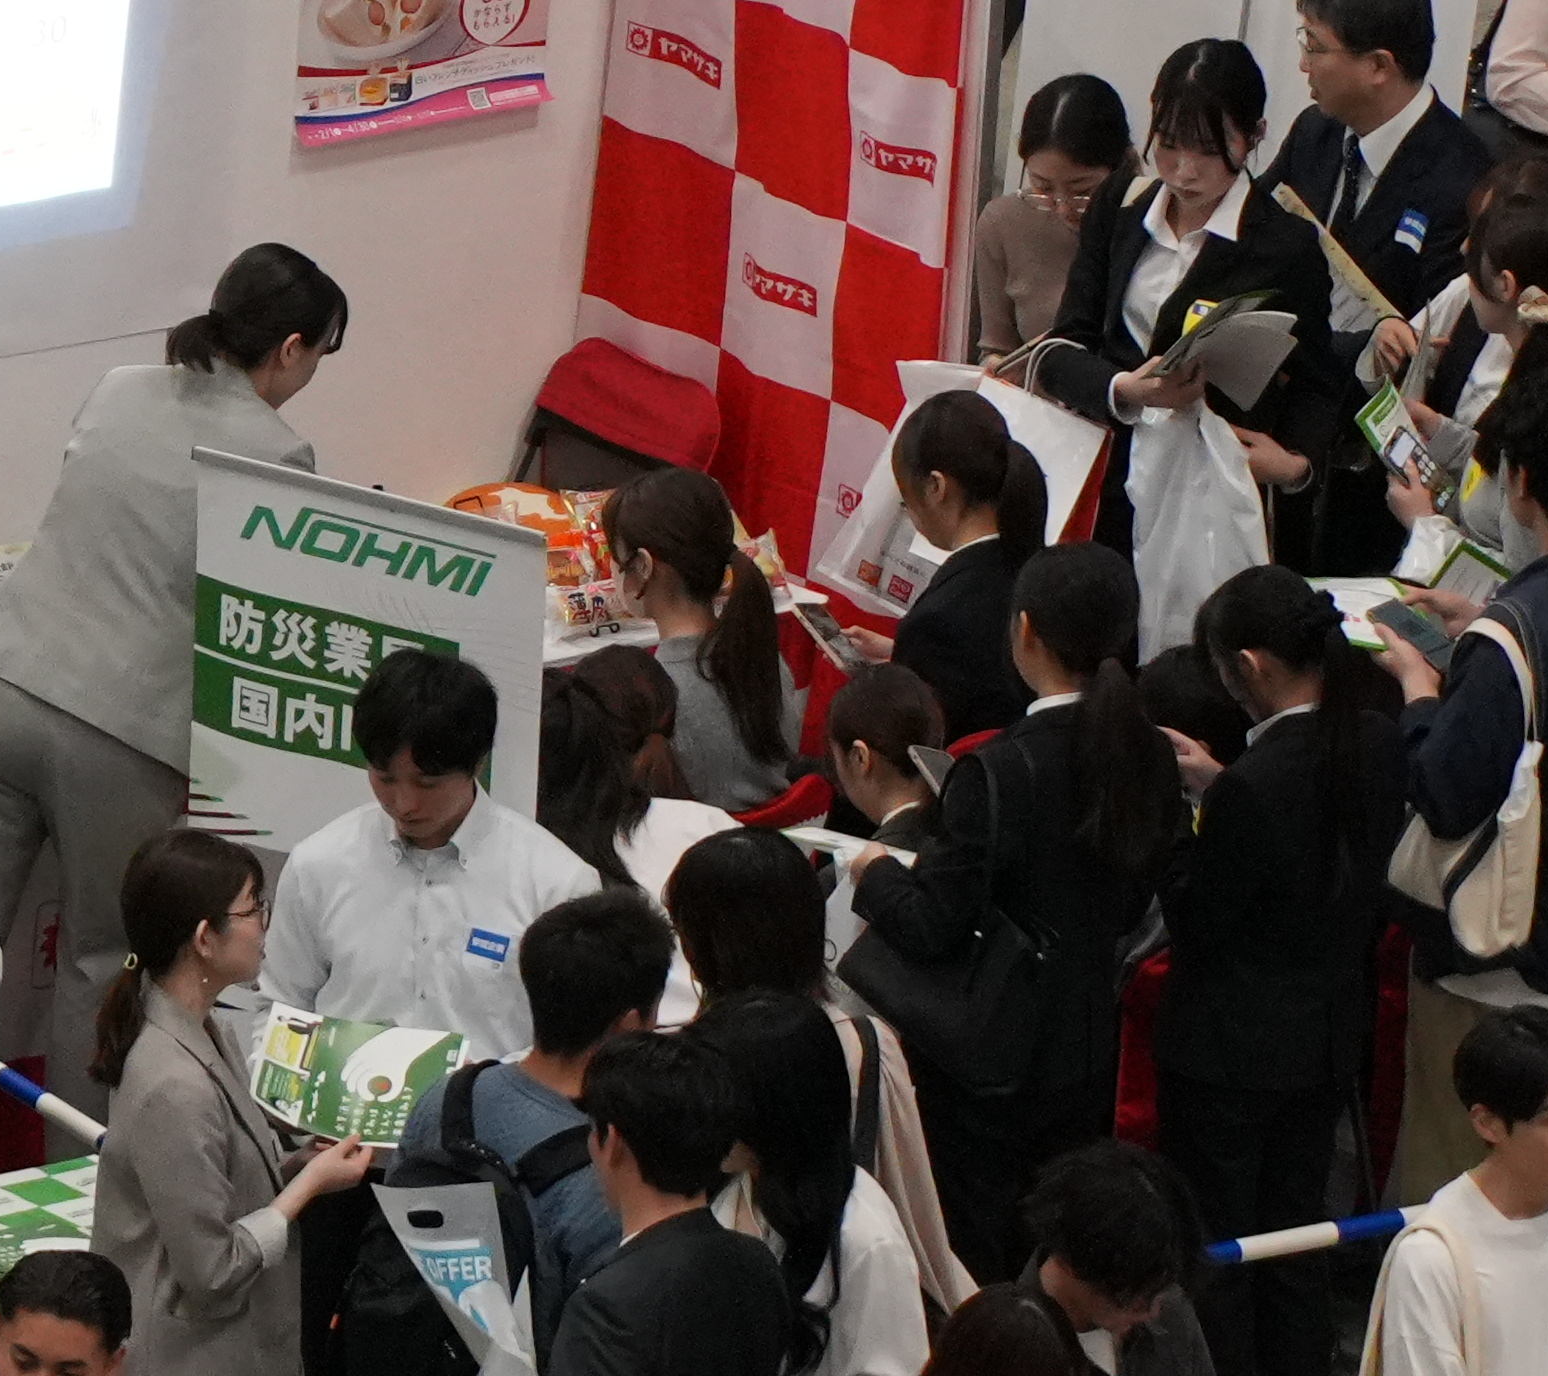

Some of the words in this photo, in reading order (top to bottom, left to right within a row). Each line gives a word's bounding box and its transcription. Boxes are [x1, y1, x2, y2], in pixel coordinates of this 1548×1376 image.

[658, 35, 718, 82] ヤマザキ
[240, 504, 497, 598] NOHMI
